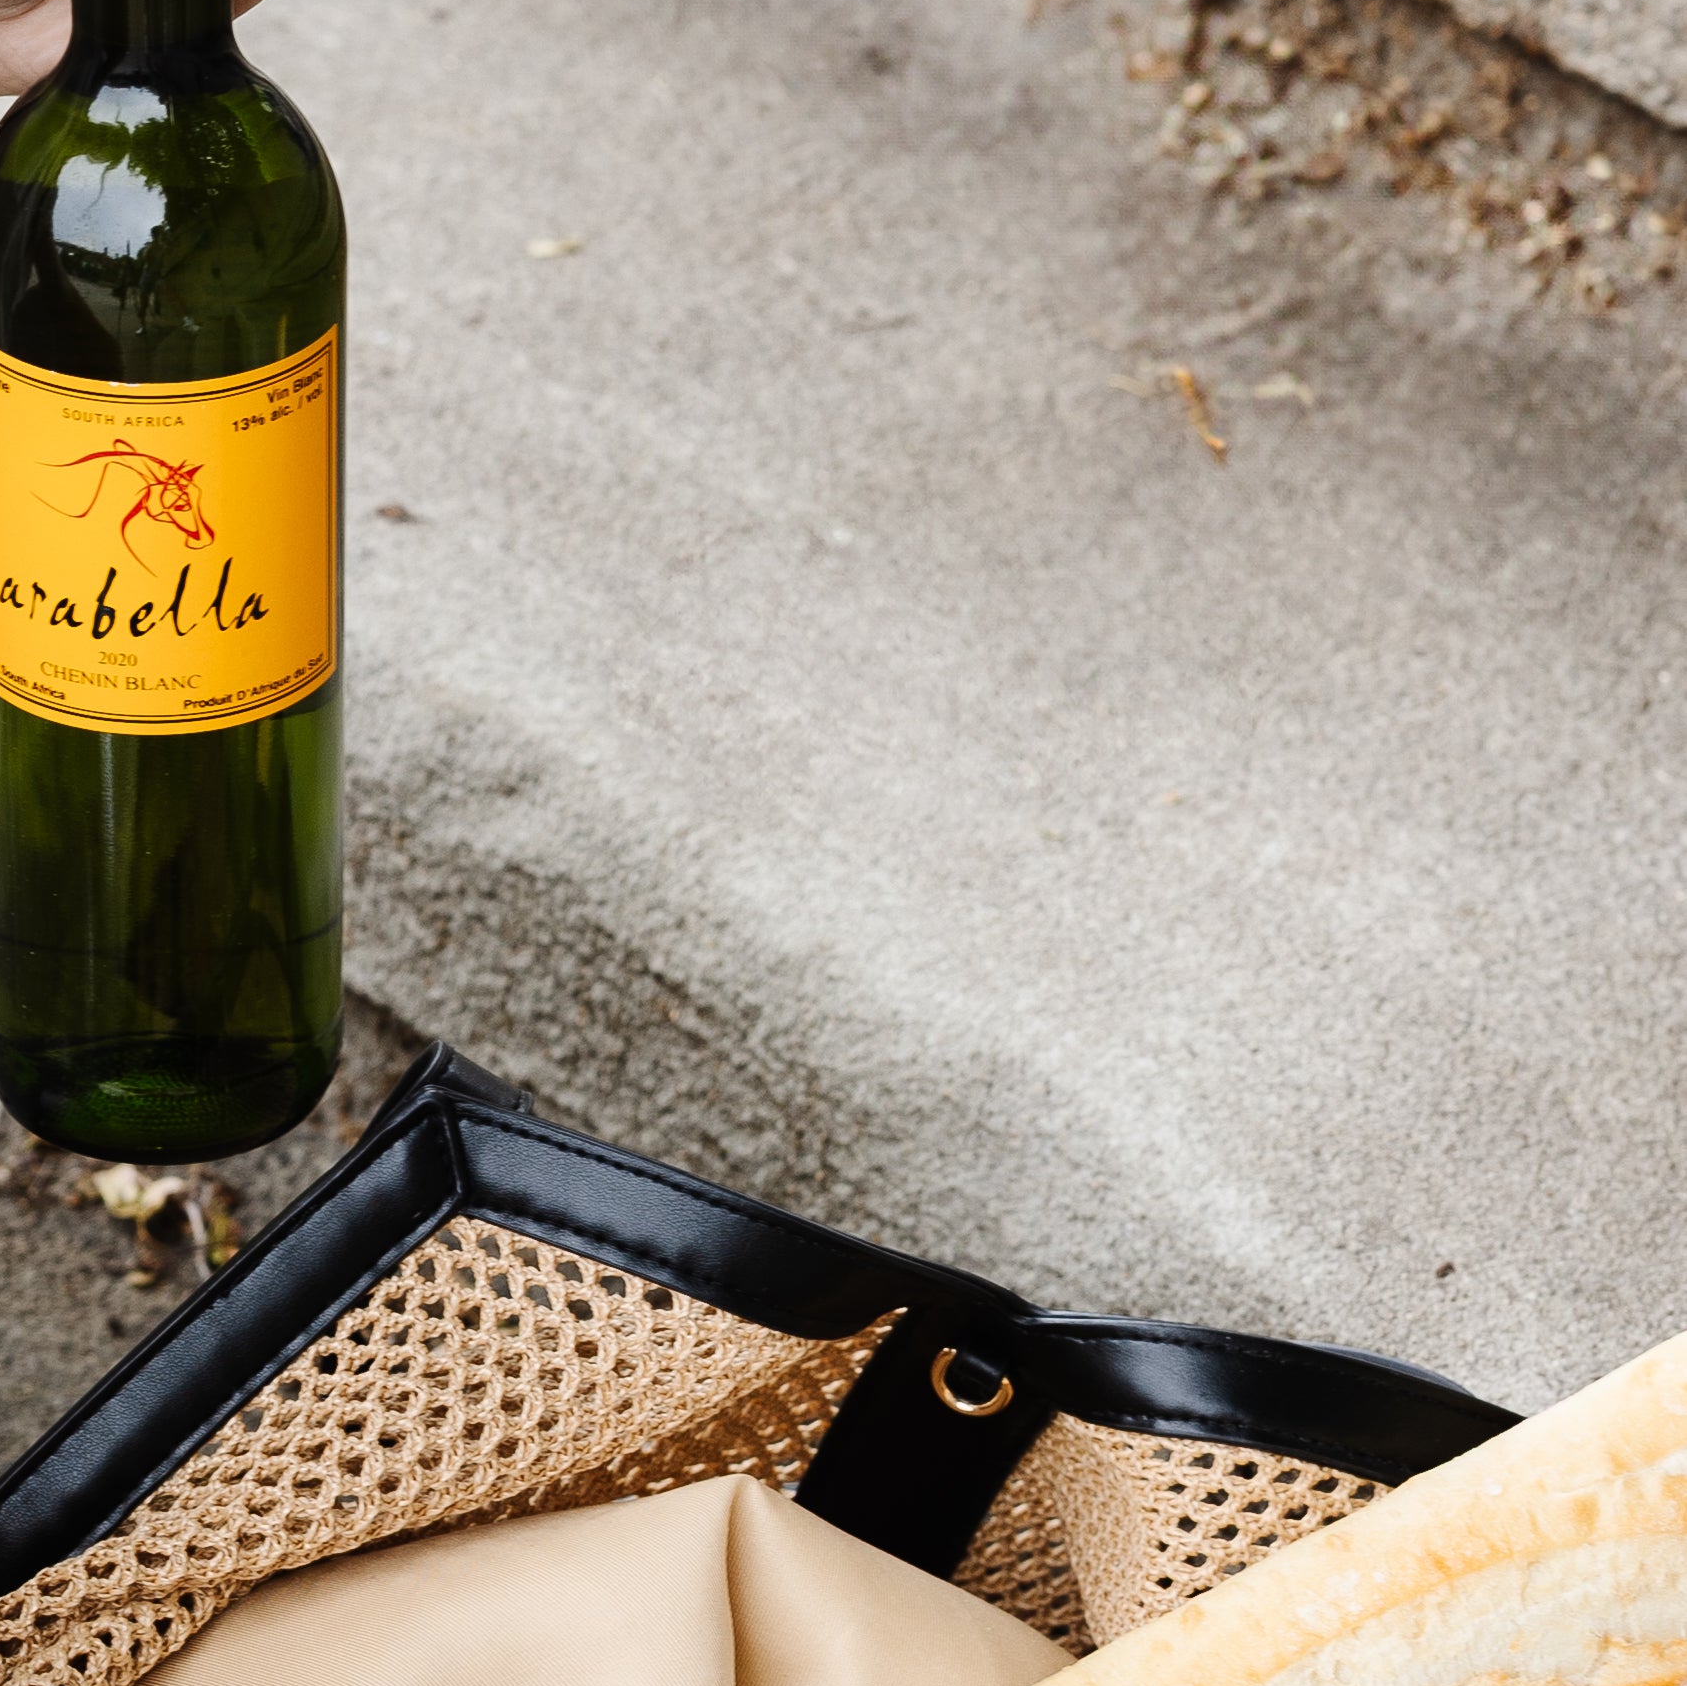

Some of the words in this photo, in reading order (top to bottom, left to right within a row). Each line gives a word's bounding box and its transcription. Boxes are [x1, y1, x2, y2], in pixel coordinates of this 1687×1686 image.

[266, 388, 290, 404] Vin
[293, 367, 323, 394] Blanc
[61, 407, 116, 426] SOUTH
[123, 415, 185, 428] AFRICA
[231, 414, 266, 432] 13%
[0, 556, 270, 640] arabella
[98, 651, 139, 667] 2020
[39, 660, 119, 689] CHENIN
[125, 673, 203, 691] BLANC
[31, 681, 66, 701] Africa
[183, 693, 233, 710] Produit
